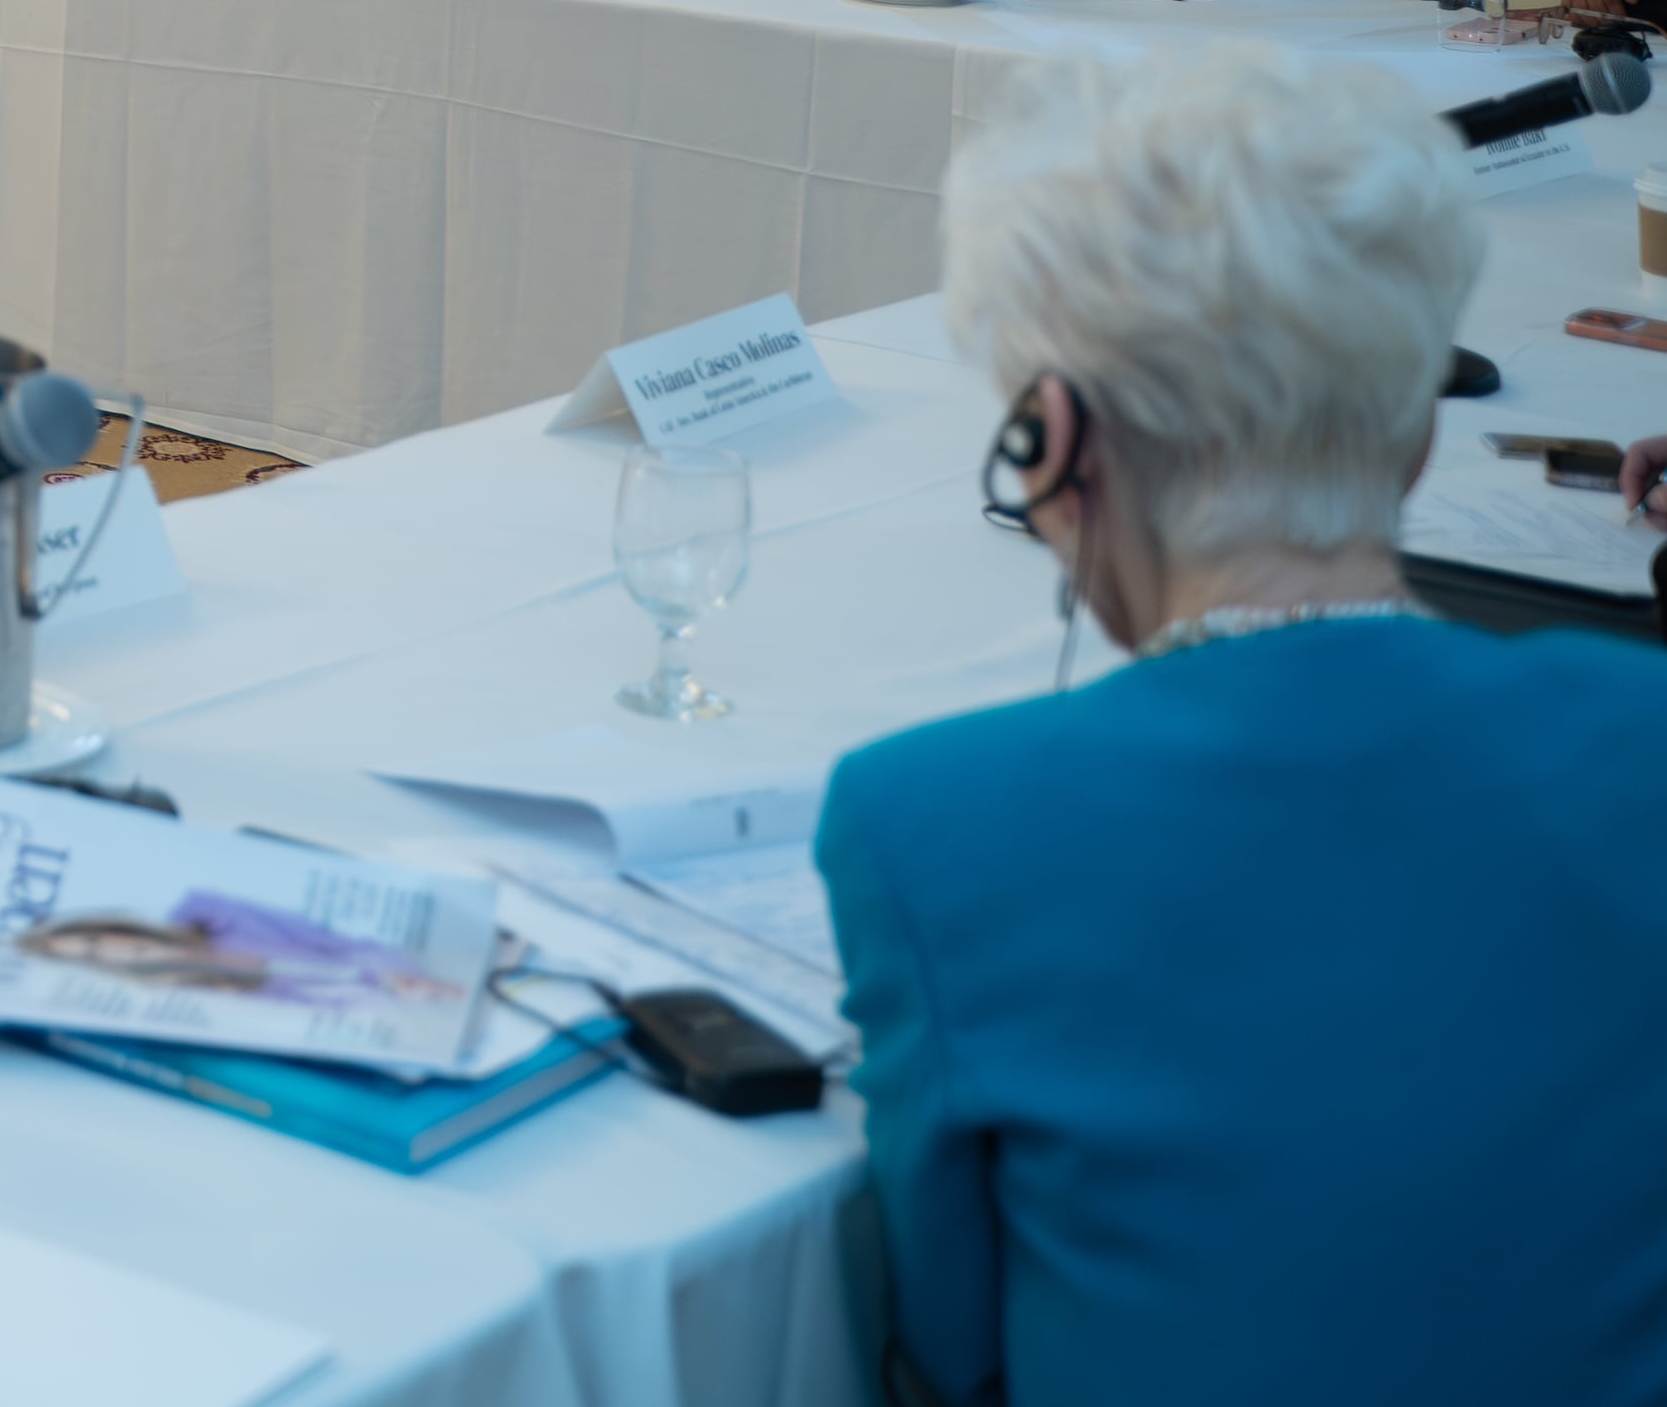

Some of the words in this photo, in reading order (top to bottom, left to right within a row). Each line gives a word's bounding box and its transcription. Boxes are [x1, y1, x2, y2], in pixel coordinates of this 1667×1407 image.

[634, 369, 697, 401] Viviana
[693, 350, 742, 380] Casco
[738, 329, 802, 363] Molinas
